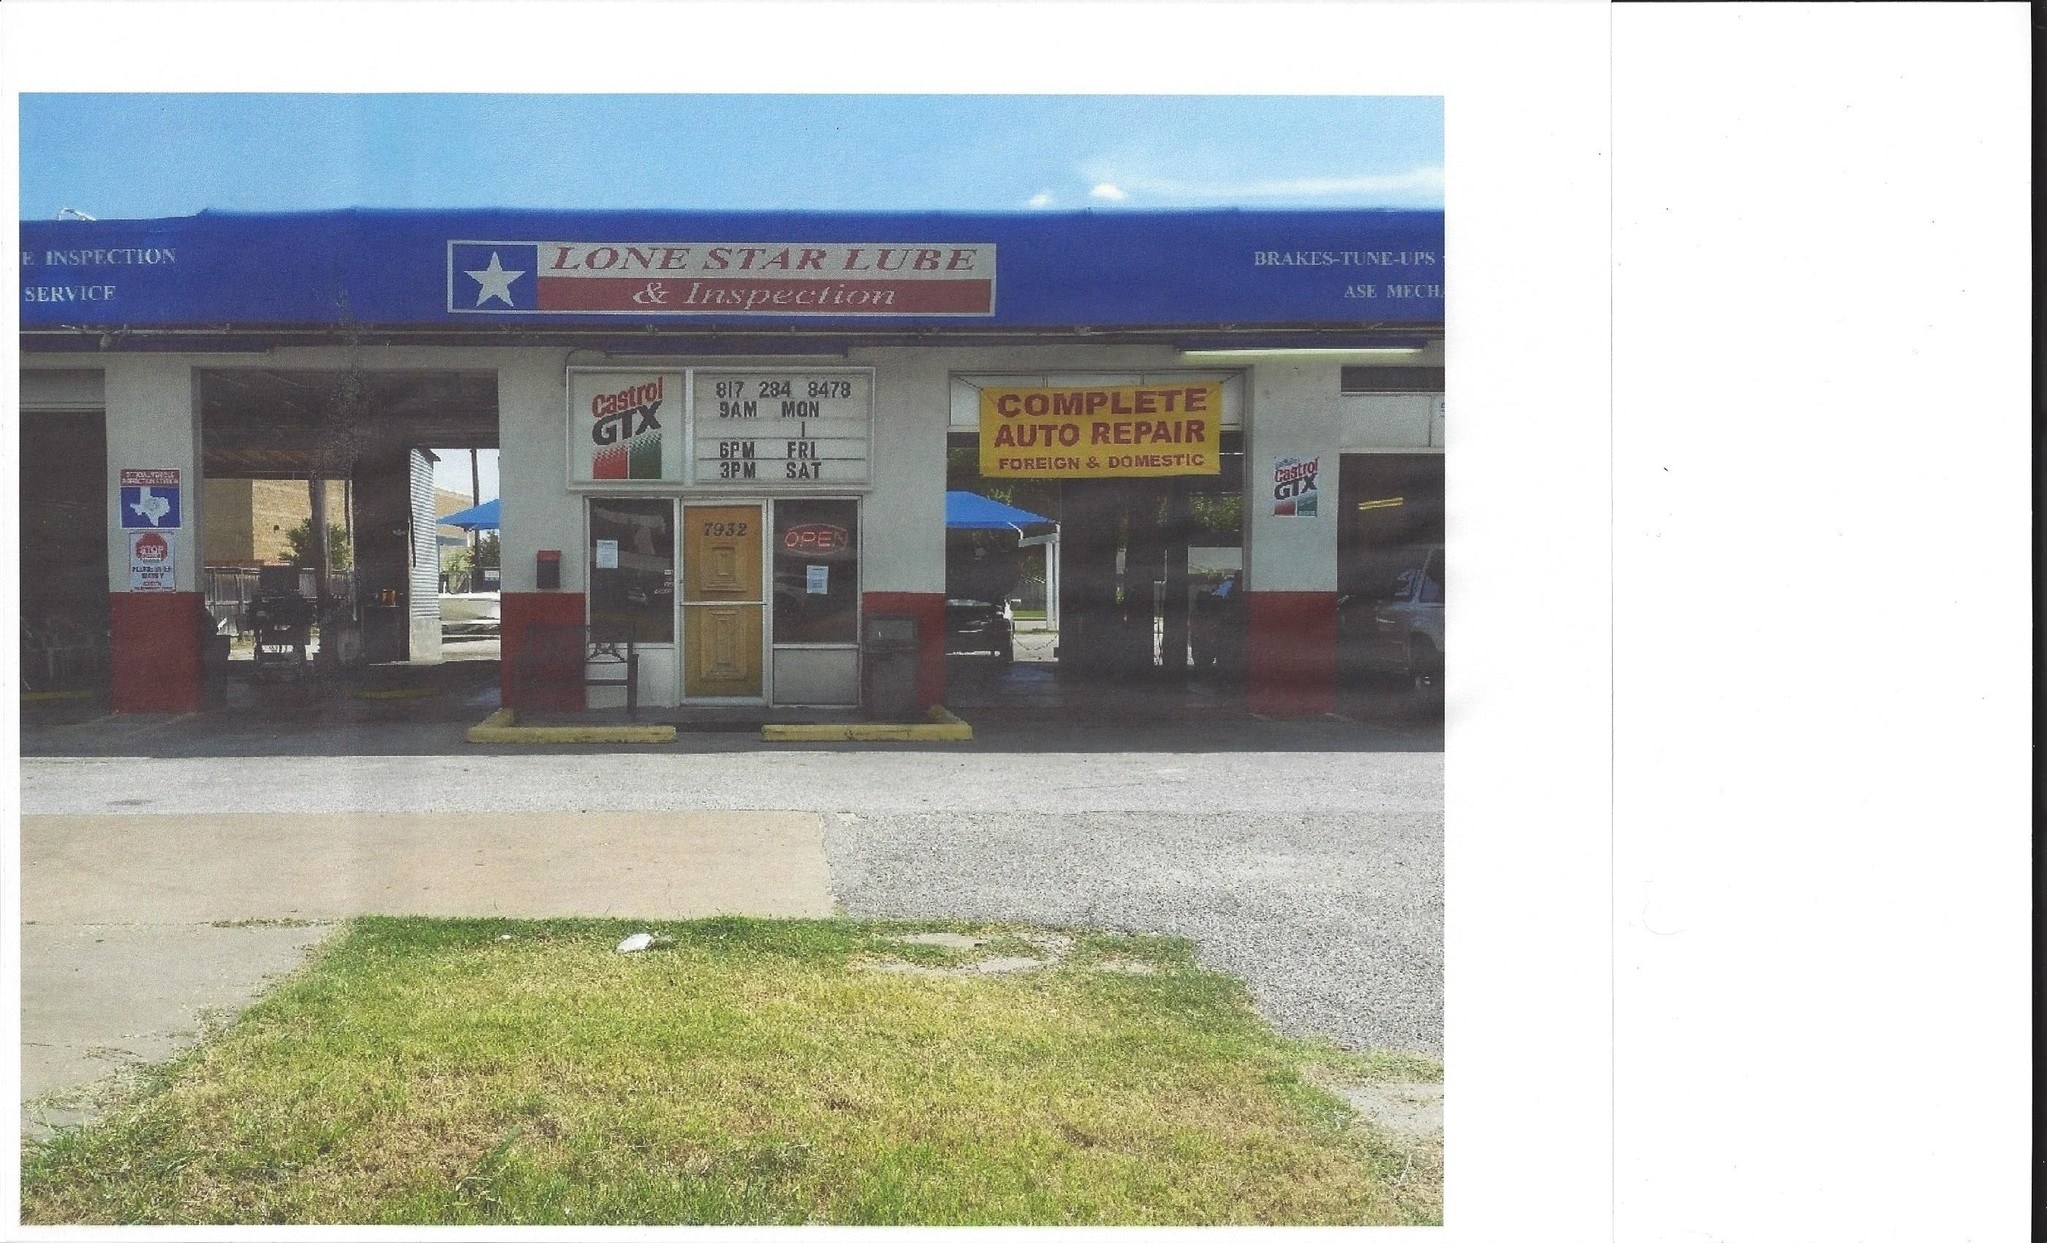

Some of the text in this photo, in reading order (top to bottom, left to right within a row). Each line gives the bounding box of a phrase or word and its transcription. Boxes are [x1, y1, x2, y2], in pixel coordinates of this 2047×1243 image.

[46, 248, 176, 265] INSPECTION
[550, 247, 978, 271] LONE STAR LUBE
[1254, 251, 1436, 266] BRAKES-TUNE-UPS
[24, 286, 116, 302] SERVICE
[632, 283, 897, 309] & Inspection
[1344, 285, 1378, 298] ASE
[592, 375, 663, 418] Castrol
[716, 381, 851, 398] 817 284 8478
[719, 401, 819, 418] 9AM MON
[997, 388, 1207, 418] COMPLETE
[592, 400, 662, 446] GTX
[994, 419, 1205, 448] AUTO REPAIR
[719, 441, 816, 458] 6PM FRI
[720, 461, 822, 479] 3PM SAT
[999, 454, 1205, 470] FOREIGN & DOMESTIC
[1275, 457, 1319, 482] Castrol
[1274, 473, 1317, 500] GTX
[704, 521, 748, 536] 7932
[785, 530, 847, 549] OPEN
